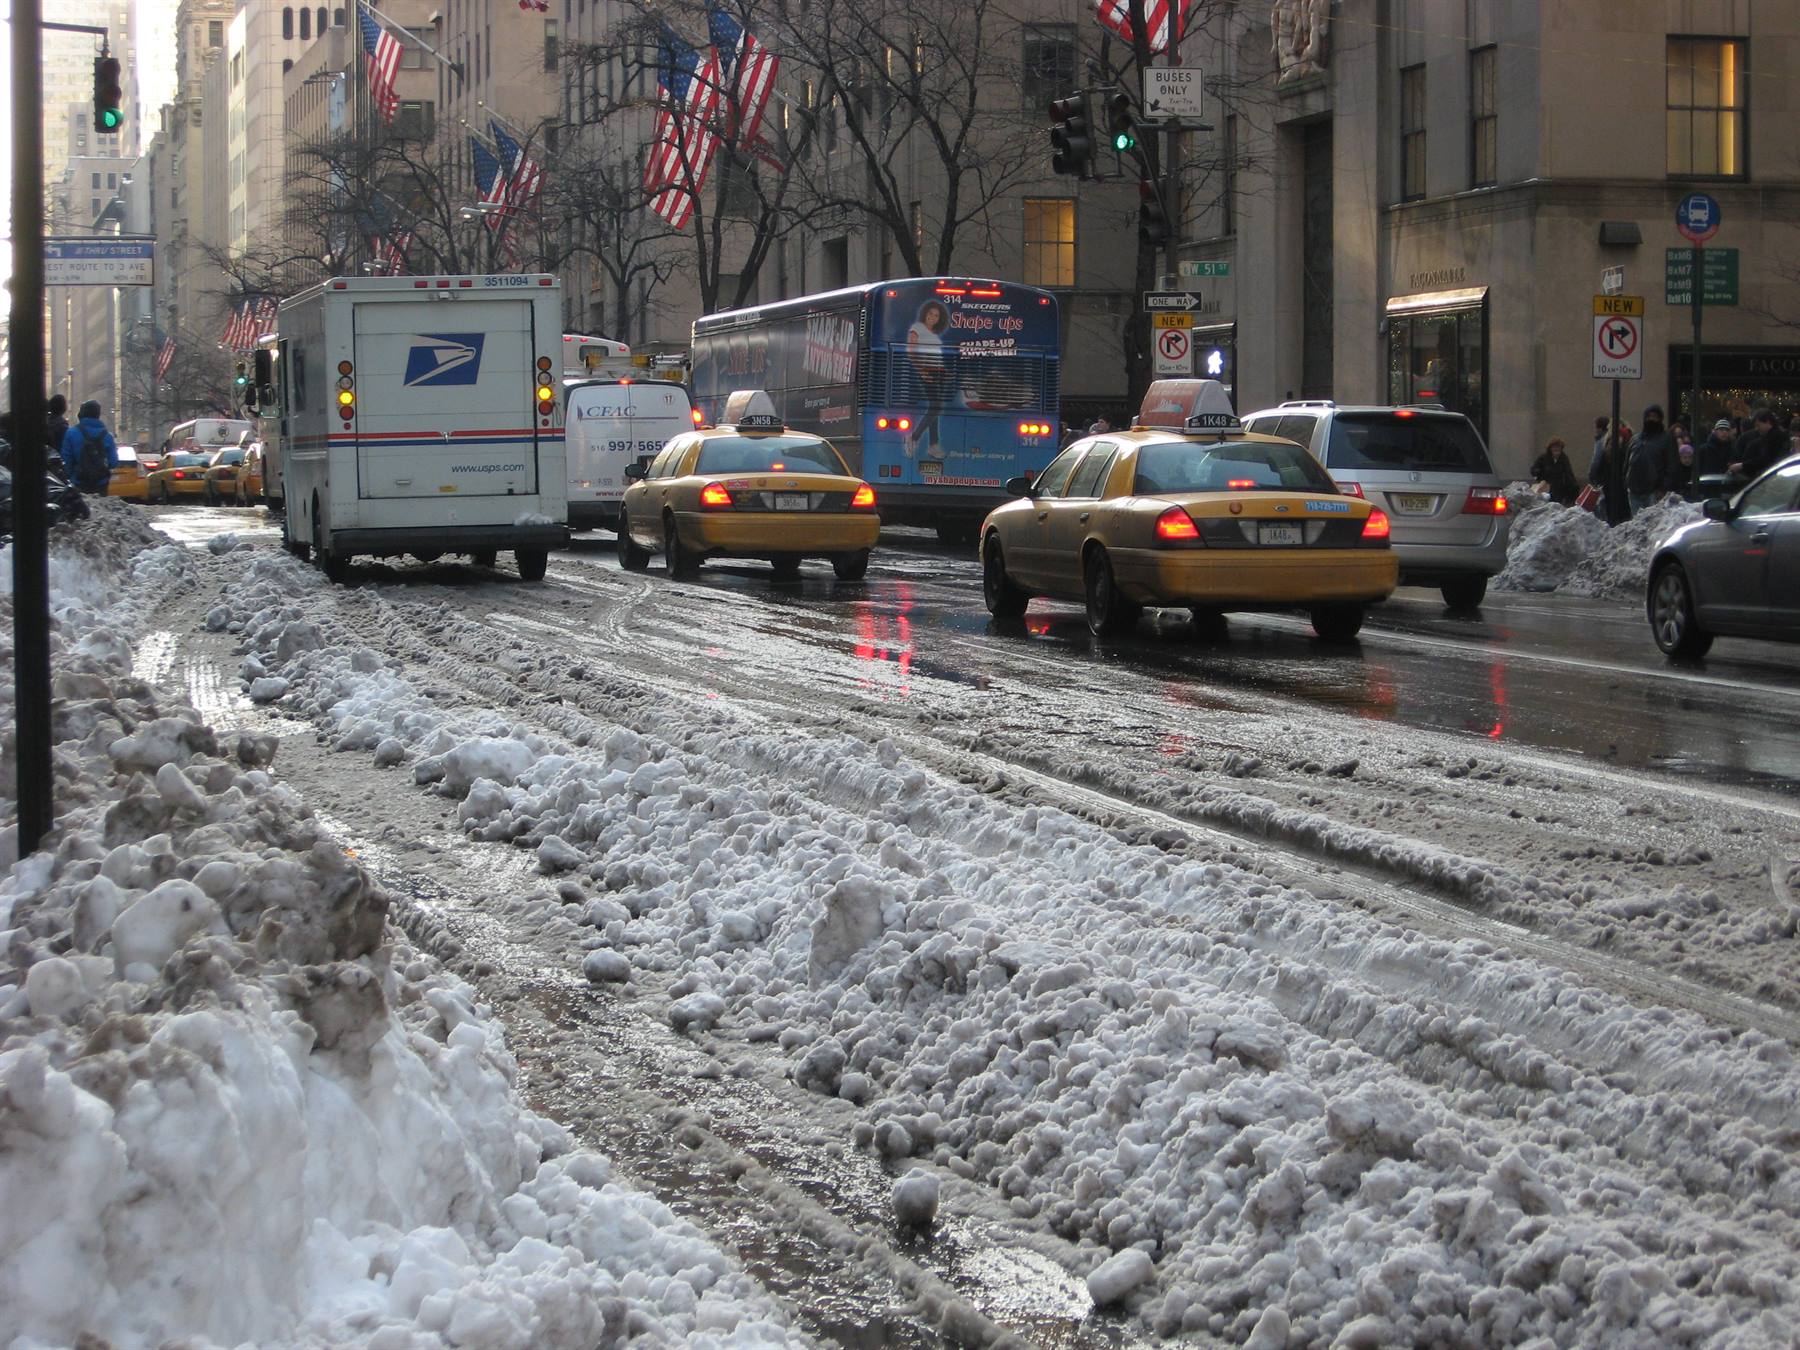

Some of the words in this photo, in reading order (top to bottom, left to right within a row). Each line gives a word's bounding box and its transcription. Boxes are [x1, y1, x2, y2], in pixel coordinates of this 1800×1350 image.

[1156, 73, 1191, 82] BUSES
[1160, 85, 1187, 95] ONLY
[110, 247, 142, 255] STREET
[47, 263, 63, 271] EST
[70, 263, 98, 271] ROUTE
[104, 263, 114, 271] TO
[129, 263, 145, 271] AVE
[1205, 264, 1216, 275] 51
[485, 277, 528, 287] 3511094
[944, 295, 961, 304] 314
[1603, 300, 1633, 312] NEW
[951, 312, 993, 334] Shape
[998, 316, 1024, 334] ups
[1161, 316, 1185, 326] NEW
[751, 416, 771, 425] 3N58
[1202, 415, 1227, 426] 1K48
[1022, 437, 1038, 446] 314
[451, 463, 524, 474] www.usps.com
